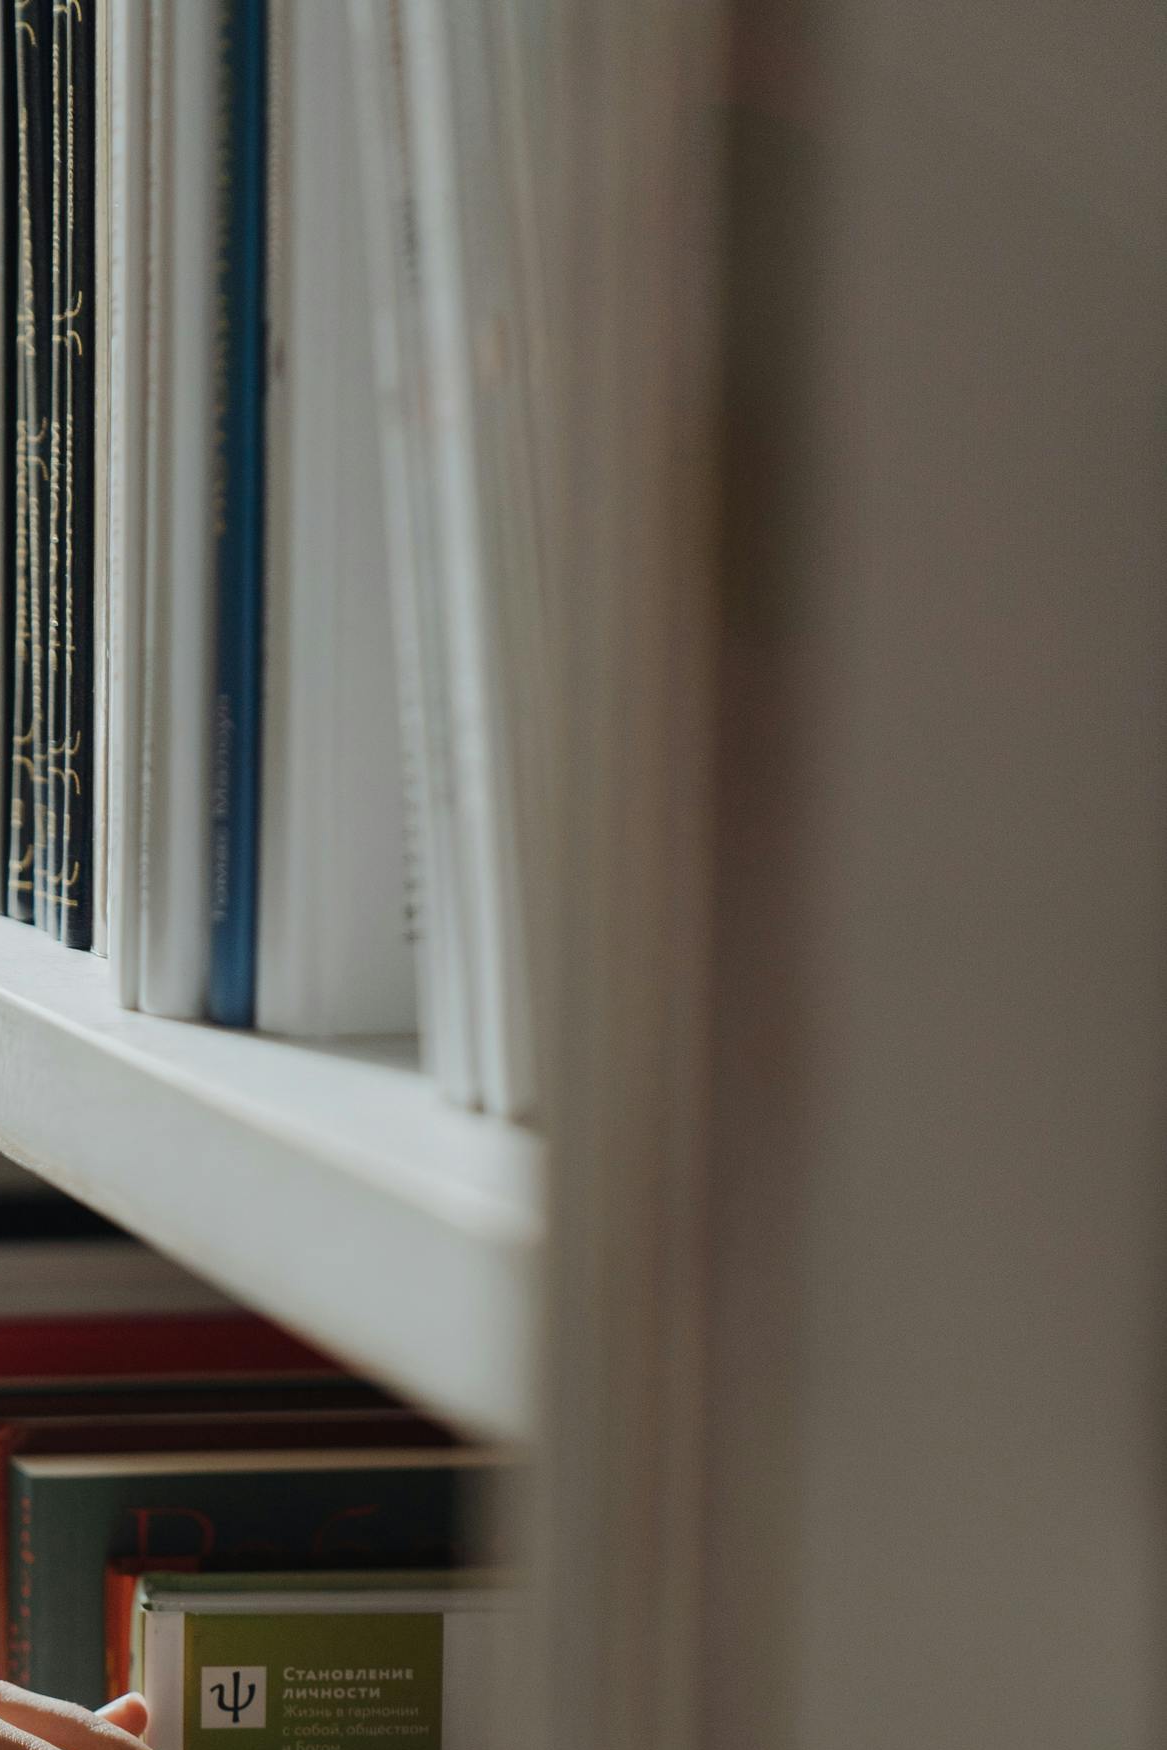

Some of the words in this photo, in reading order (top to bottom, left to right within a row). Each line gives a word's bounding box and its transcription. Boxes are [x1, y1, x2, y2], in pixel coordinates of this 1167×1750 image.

[49, 422, 61, 575] ФРОММ
[49, 586, 61, 672] Эрих
[282, 1704, 333, 1719] Жизнь
[336, 1708, 345, 1718] в
[348, 1706, 420, 1721] гармонии
[282, 1726, 290, 1736] с
[346, 1722, 431, 1736] обществом
